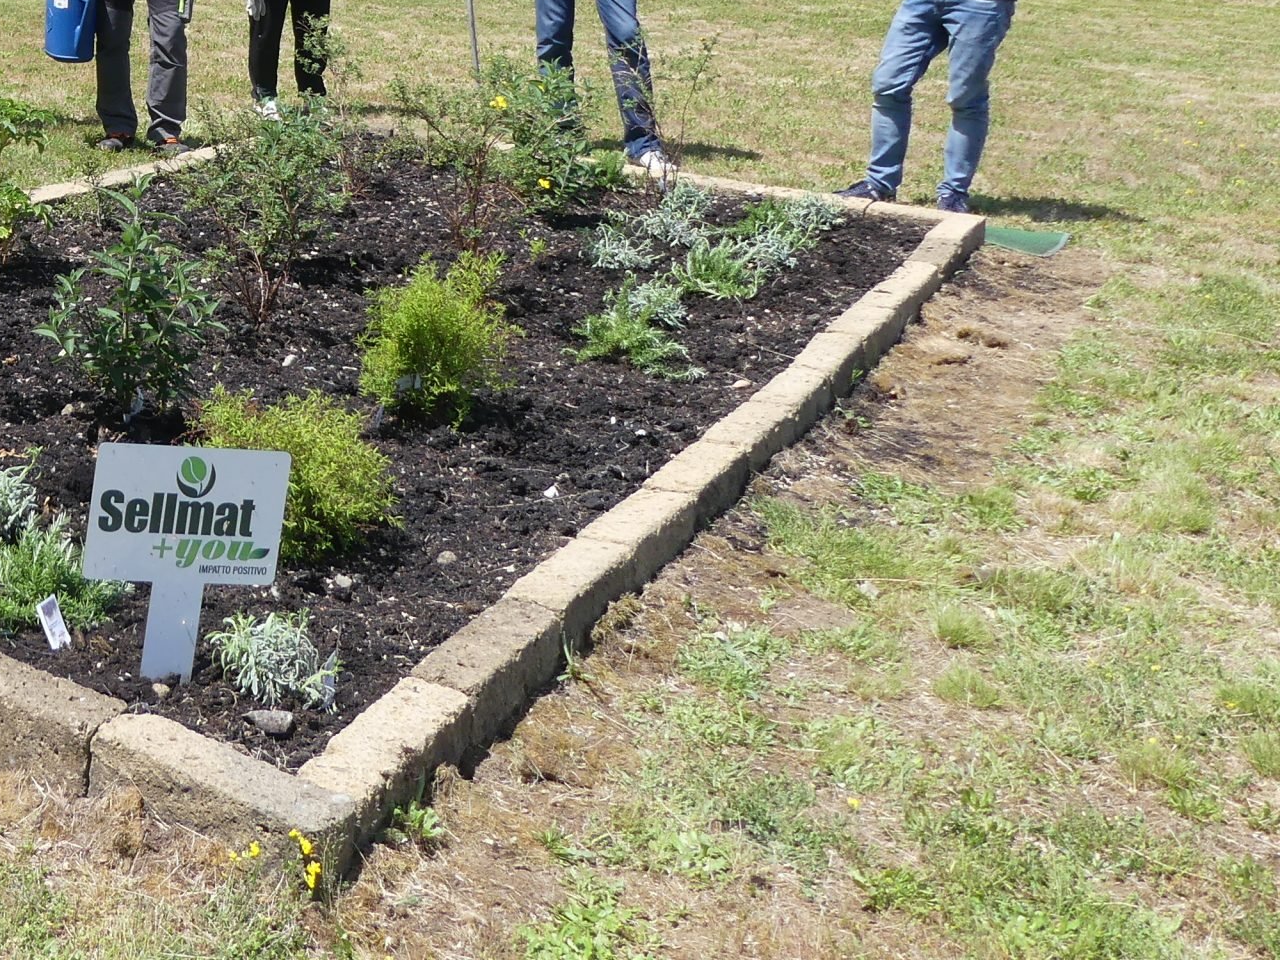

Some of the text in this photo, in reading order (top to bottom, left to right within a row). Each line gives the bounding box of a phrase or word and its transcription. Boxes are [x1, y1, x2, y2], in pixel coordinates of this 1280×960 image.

[98, 490, 256, 537] Sellmat
[199, 565, 267, 576] IMPATTO POSITIVO
